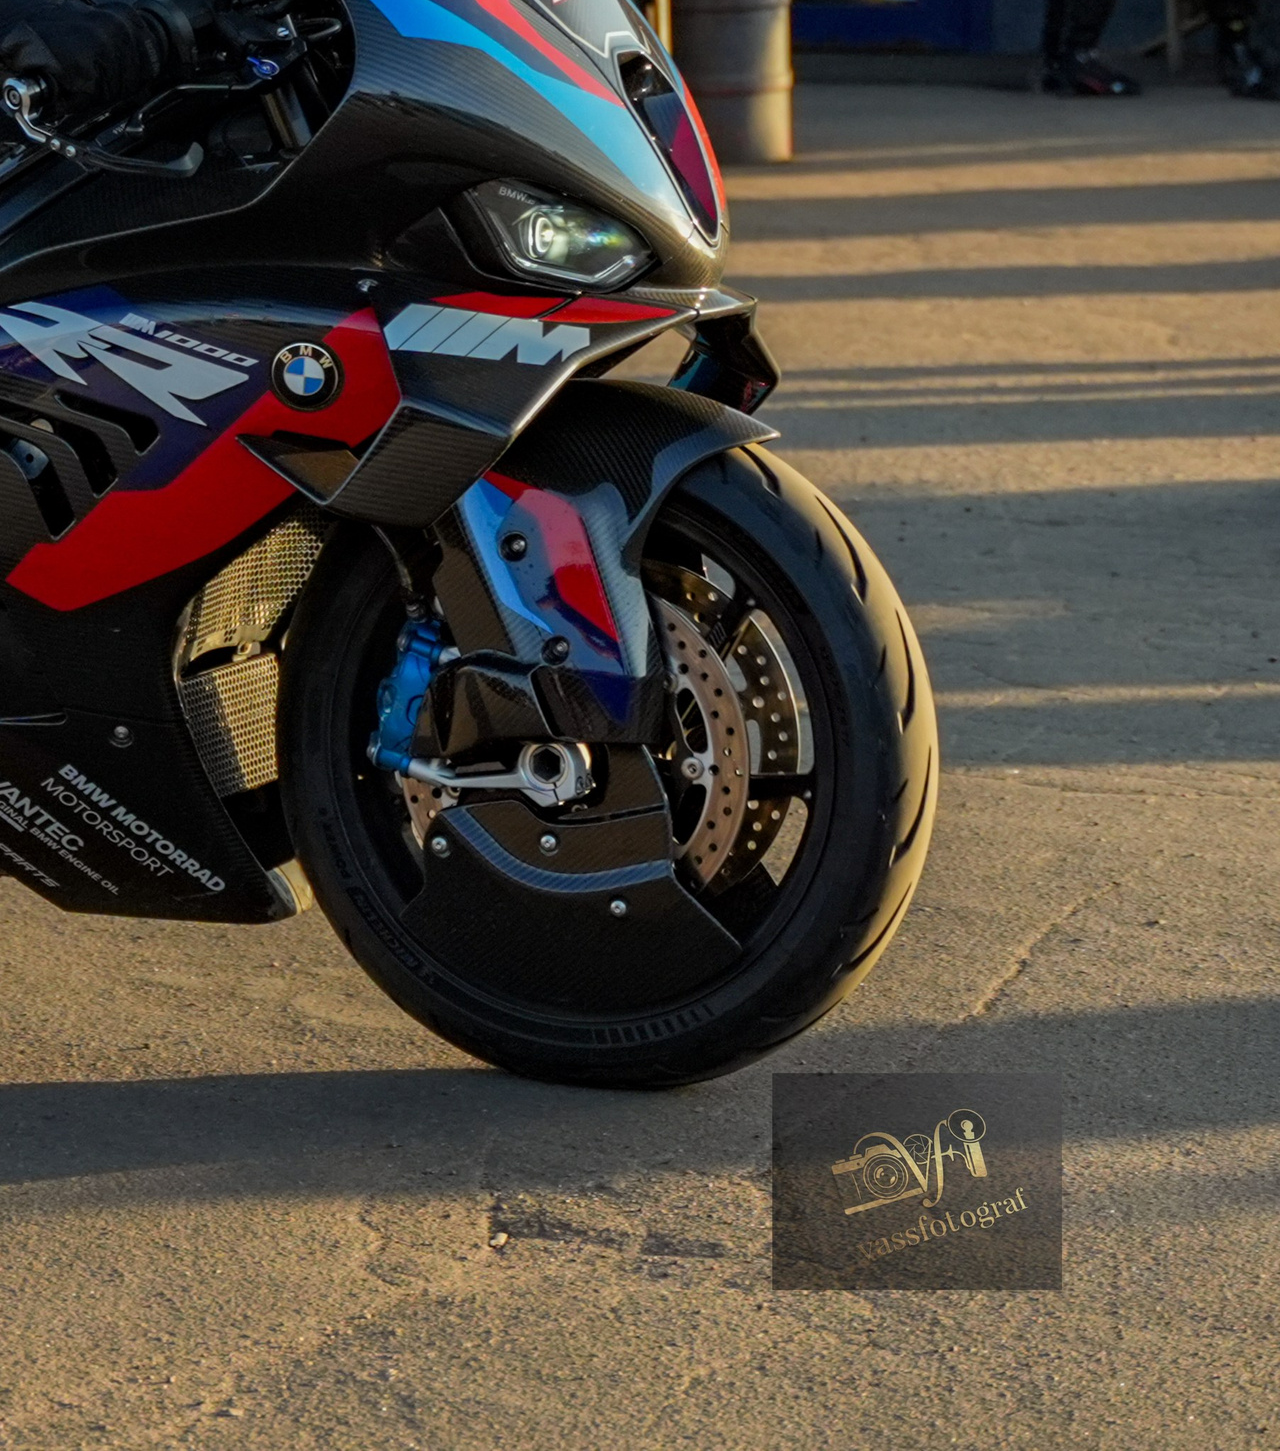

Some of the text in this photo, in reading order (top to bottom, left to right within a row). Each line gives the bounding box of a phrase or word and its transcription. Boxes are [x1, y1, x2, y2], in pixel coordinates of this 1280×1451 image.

[498, 185, 526, 201] BMW
[277, 343, 334, 370] BMW
[29, 827, 63, 851] BMW
[59, 849, 102, 883] ENGINE
[100, 879, 120, 896] OIL
[40, 777, 175, 878] MOTORSPORT
[58, 764, 226, 893] BMW MOTORRAD
